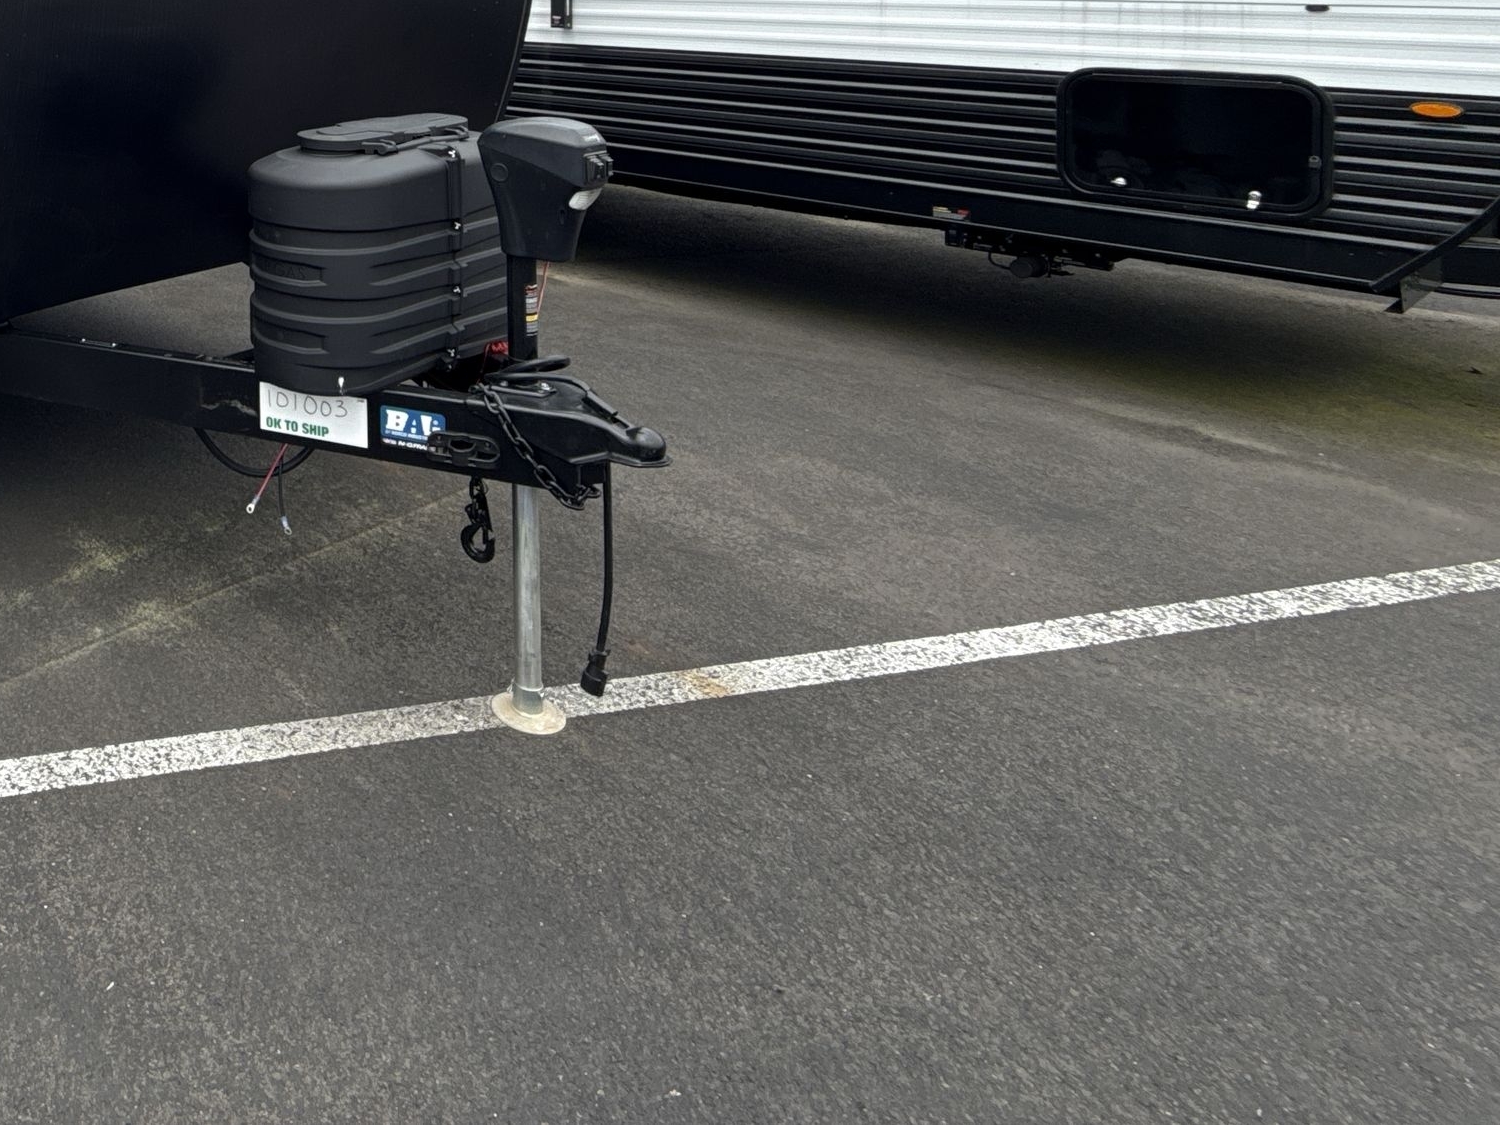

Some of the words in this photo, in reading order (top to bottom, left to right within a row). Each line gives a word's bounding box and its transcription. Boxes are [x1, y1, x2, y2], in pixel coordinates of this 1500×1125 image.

[267, 390, 348, 418] 101003
[266, 416, 281, 430] OK
[284, 419, 298, 432] TO
[302, 422, 329, 437] SHIP
